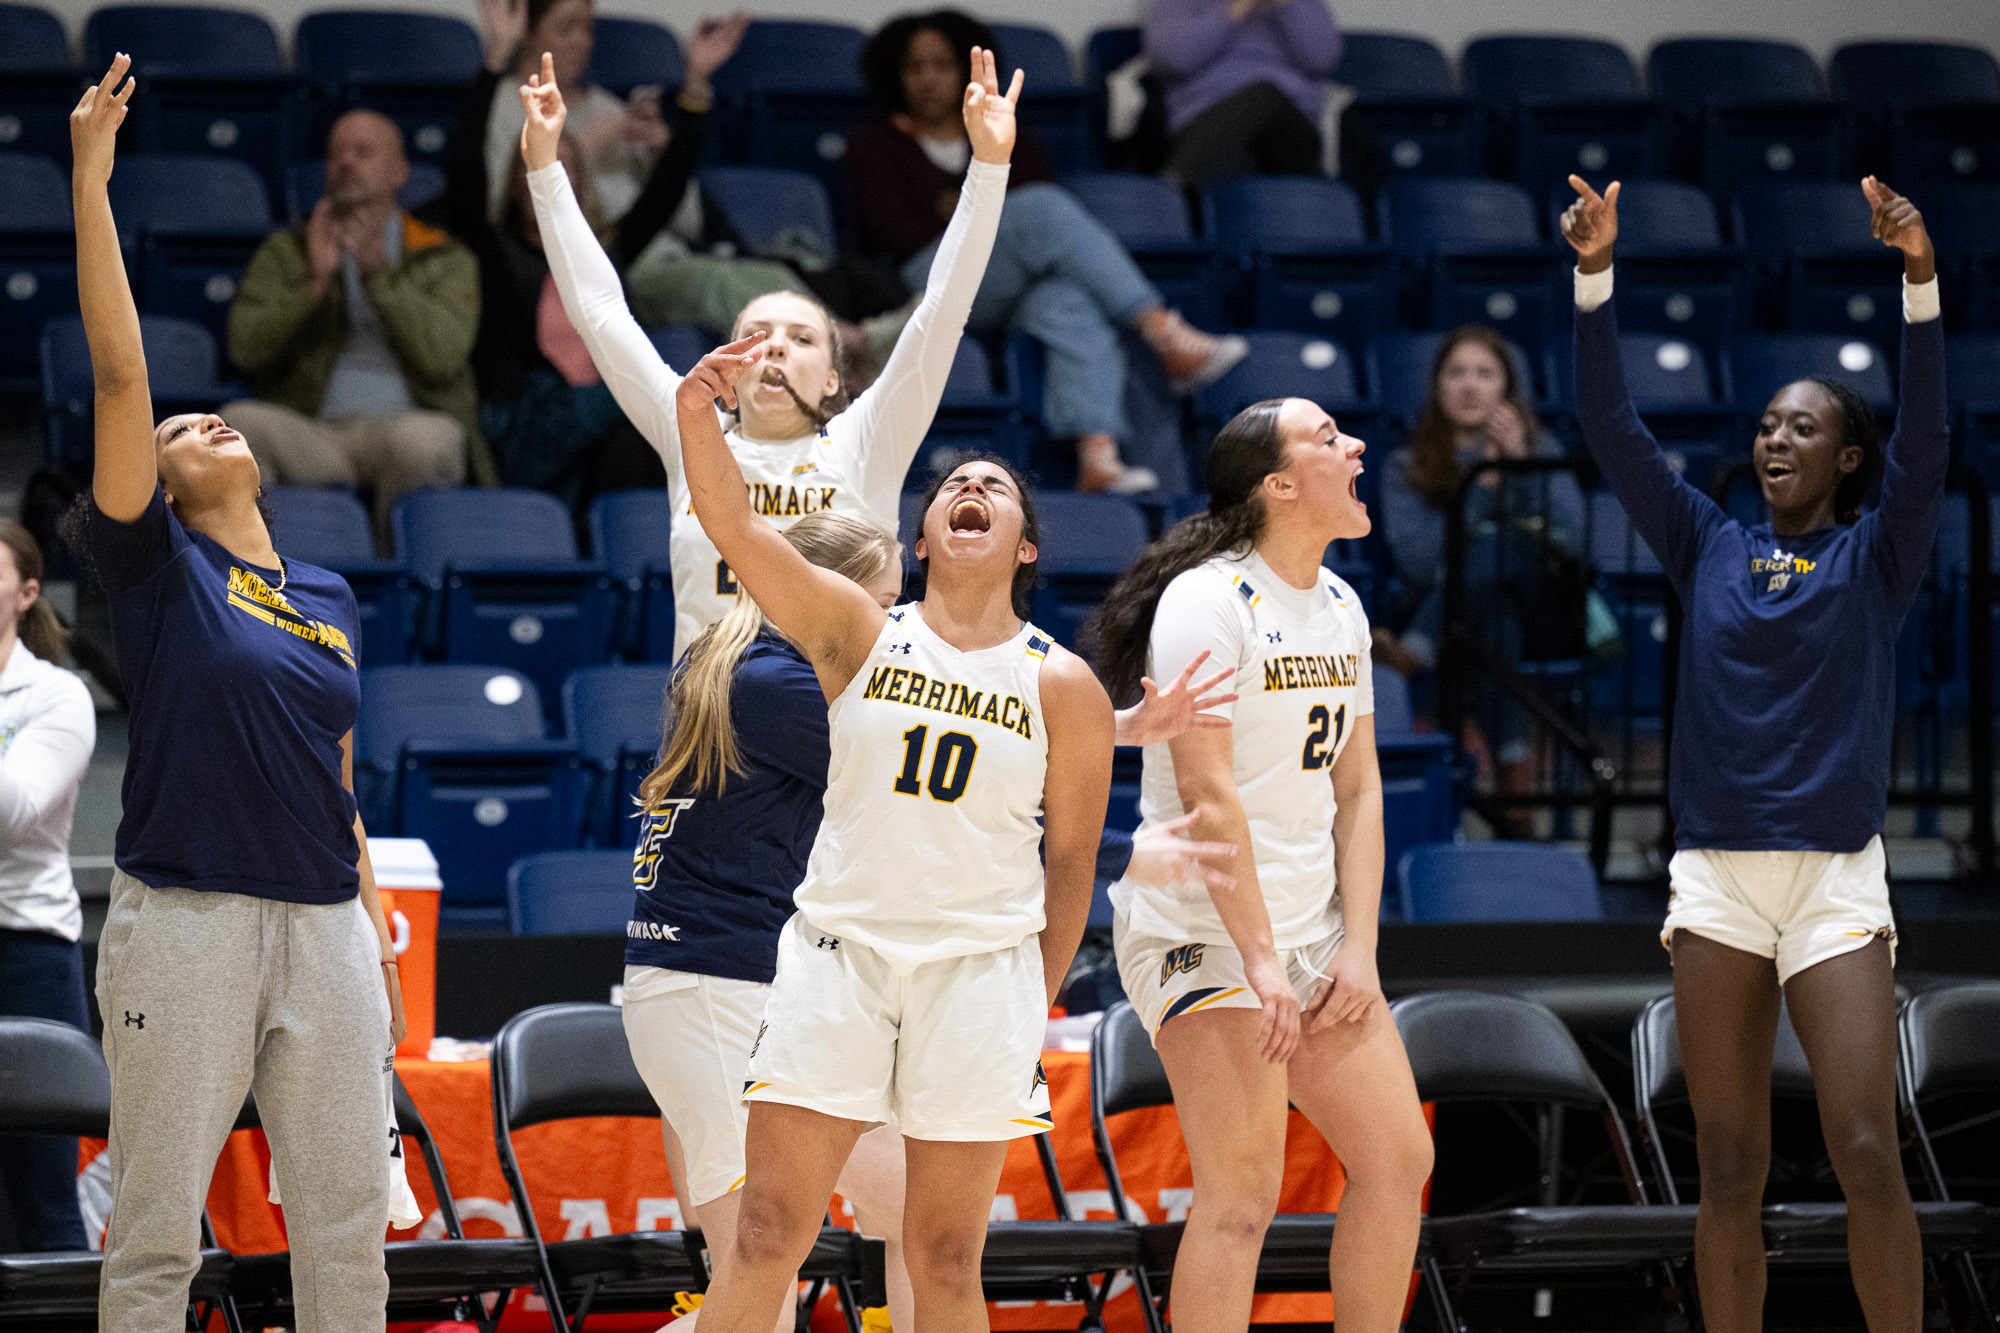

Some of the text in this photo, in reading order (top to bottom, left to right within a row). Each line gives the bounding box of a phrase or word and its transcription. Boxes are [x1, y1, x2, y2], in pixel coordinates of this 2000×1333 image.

[686, 482, 837, 517] IMACK
[863, 665, 1033, 741] MERRIMACK
[1263, 654, 1357, 692] MERRIMAC
[892, 722, 980, 804] 10
[1302, 703, 1346, 771] 21
